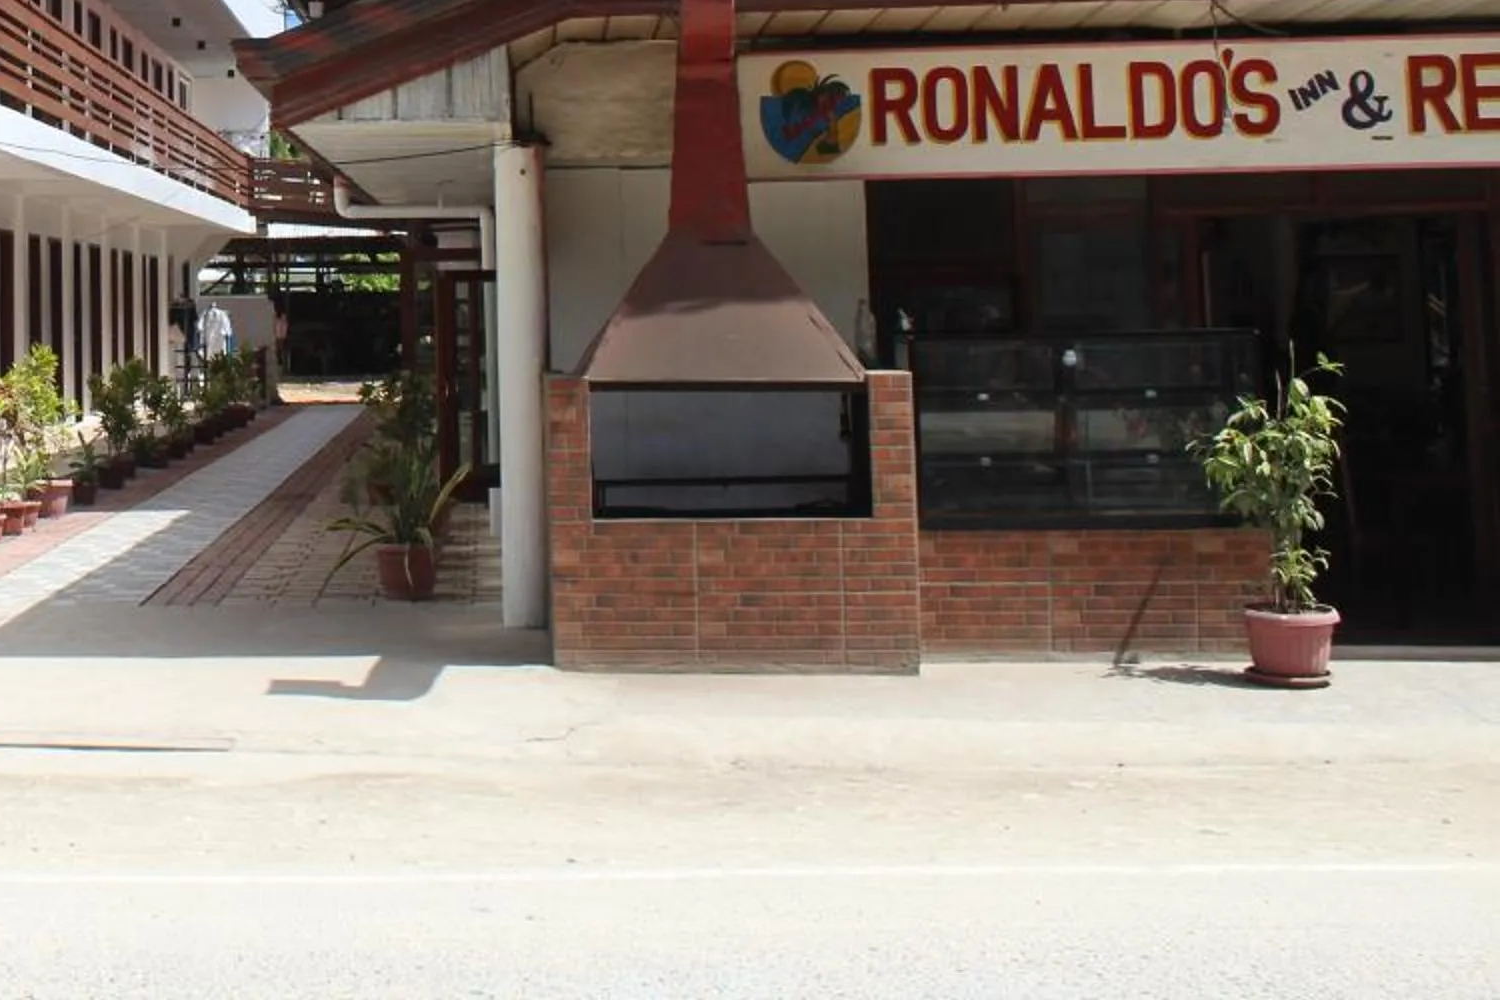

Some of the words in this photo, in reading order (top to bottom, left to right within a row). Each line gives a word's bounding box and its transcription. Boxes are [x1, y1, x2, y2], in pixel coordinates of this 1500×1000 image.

[868, 47, 1281, 146] RONALDO'S
[1287, 69, 1341, 112] INN
[1341, 69, 1394, 130] &
